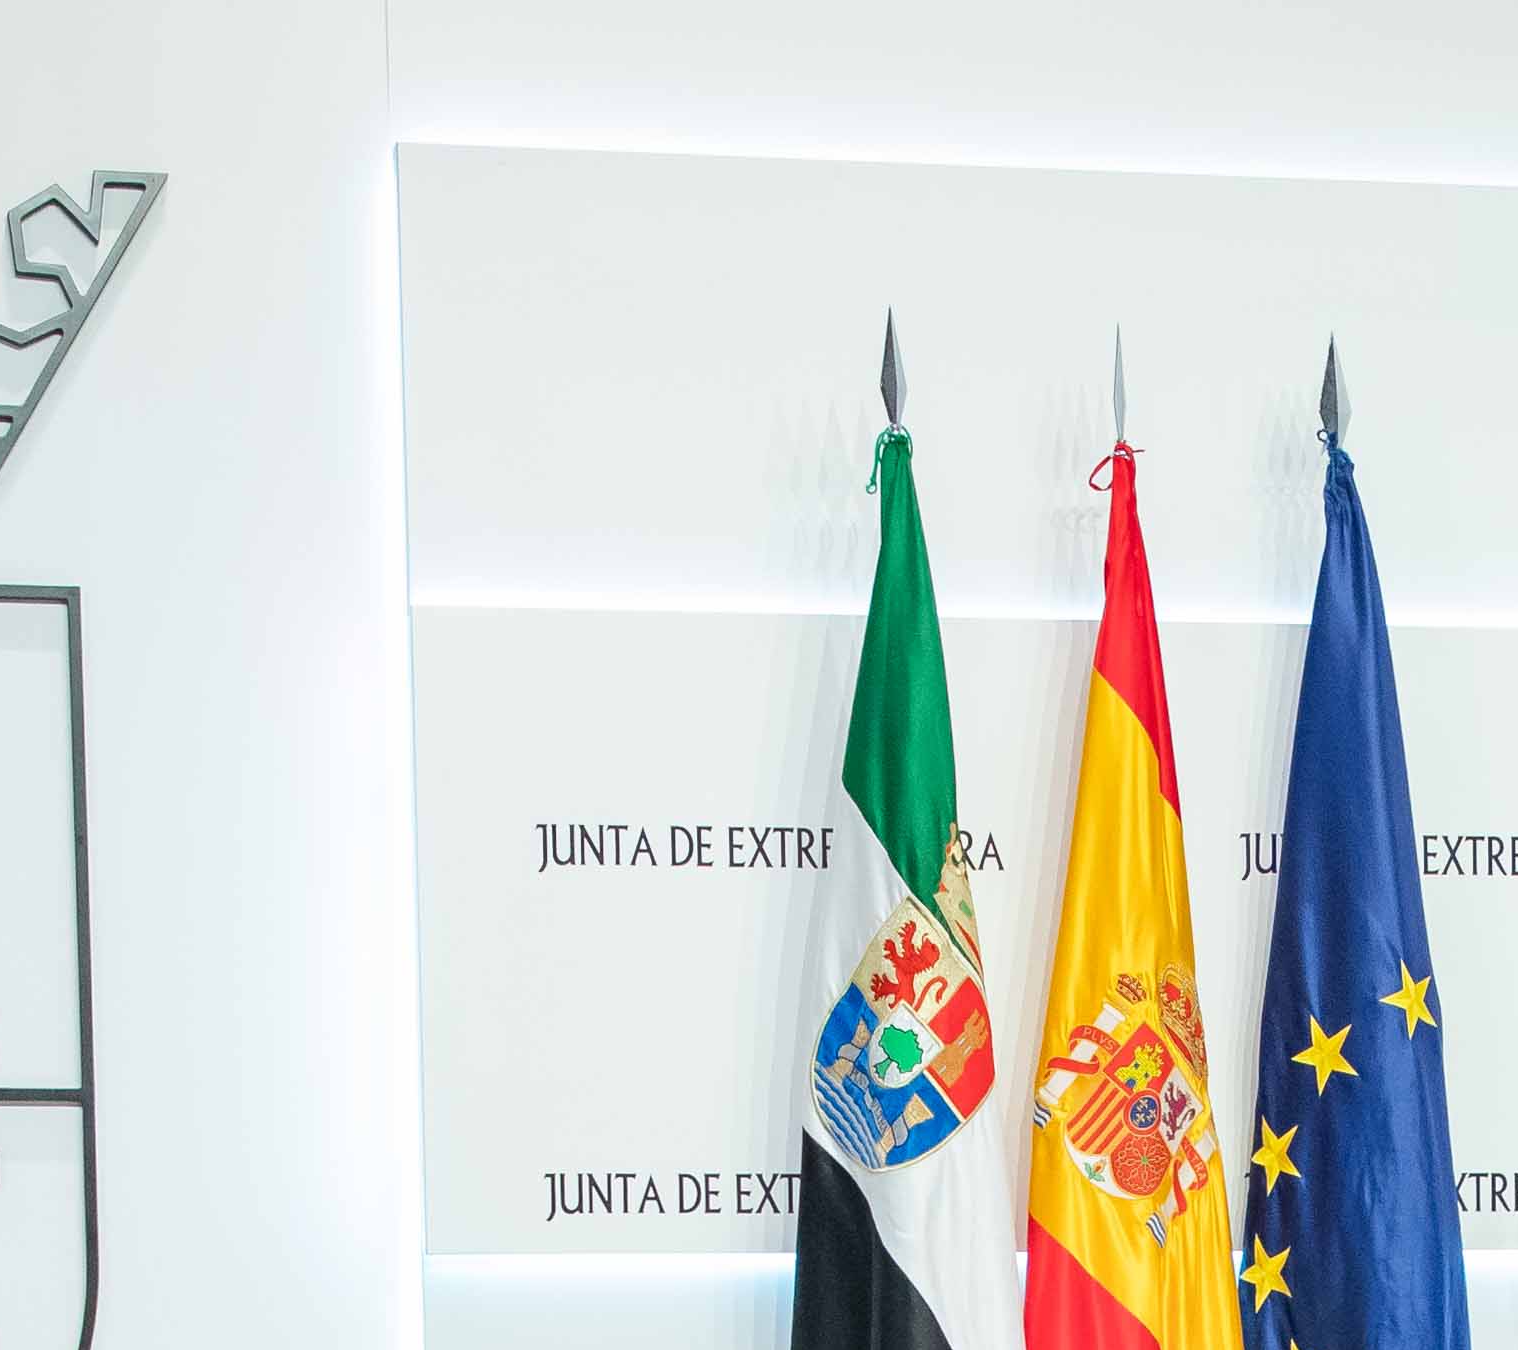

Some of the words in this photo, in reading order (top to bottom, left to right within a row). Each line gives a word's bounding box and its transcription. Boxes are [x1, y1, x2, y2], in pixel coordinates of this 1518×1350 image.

[536, 823, 657, 873] JUNTA
[670, 826, 714, 868] DE
[728, 826, 1005, 870] EXTRERA
[544, 1173, 665, 1222] JUNTA
[678, 1173, 721, 1214] DE
